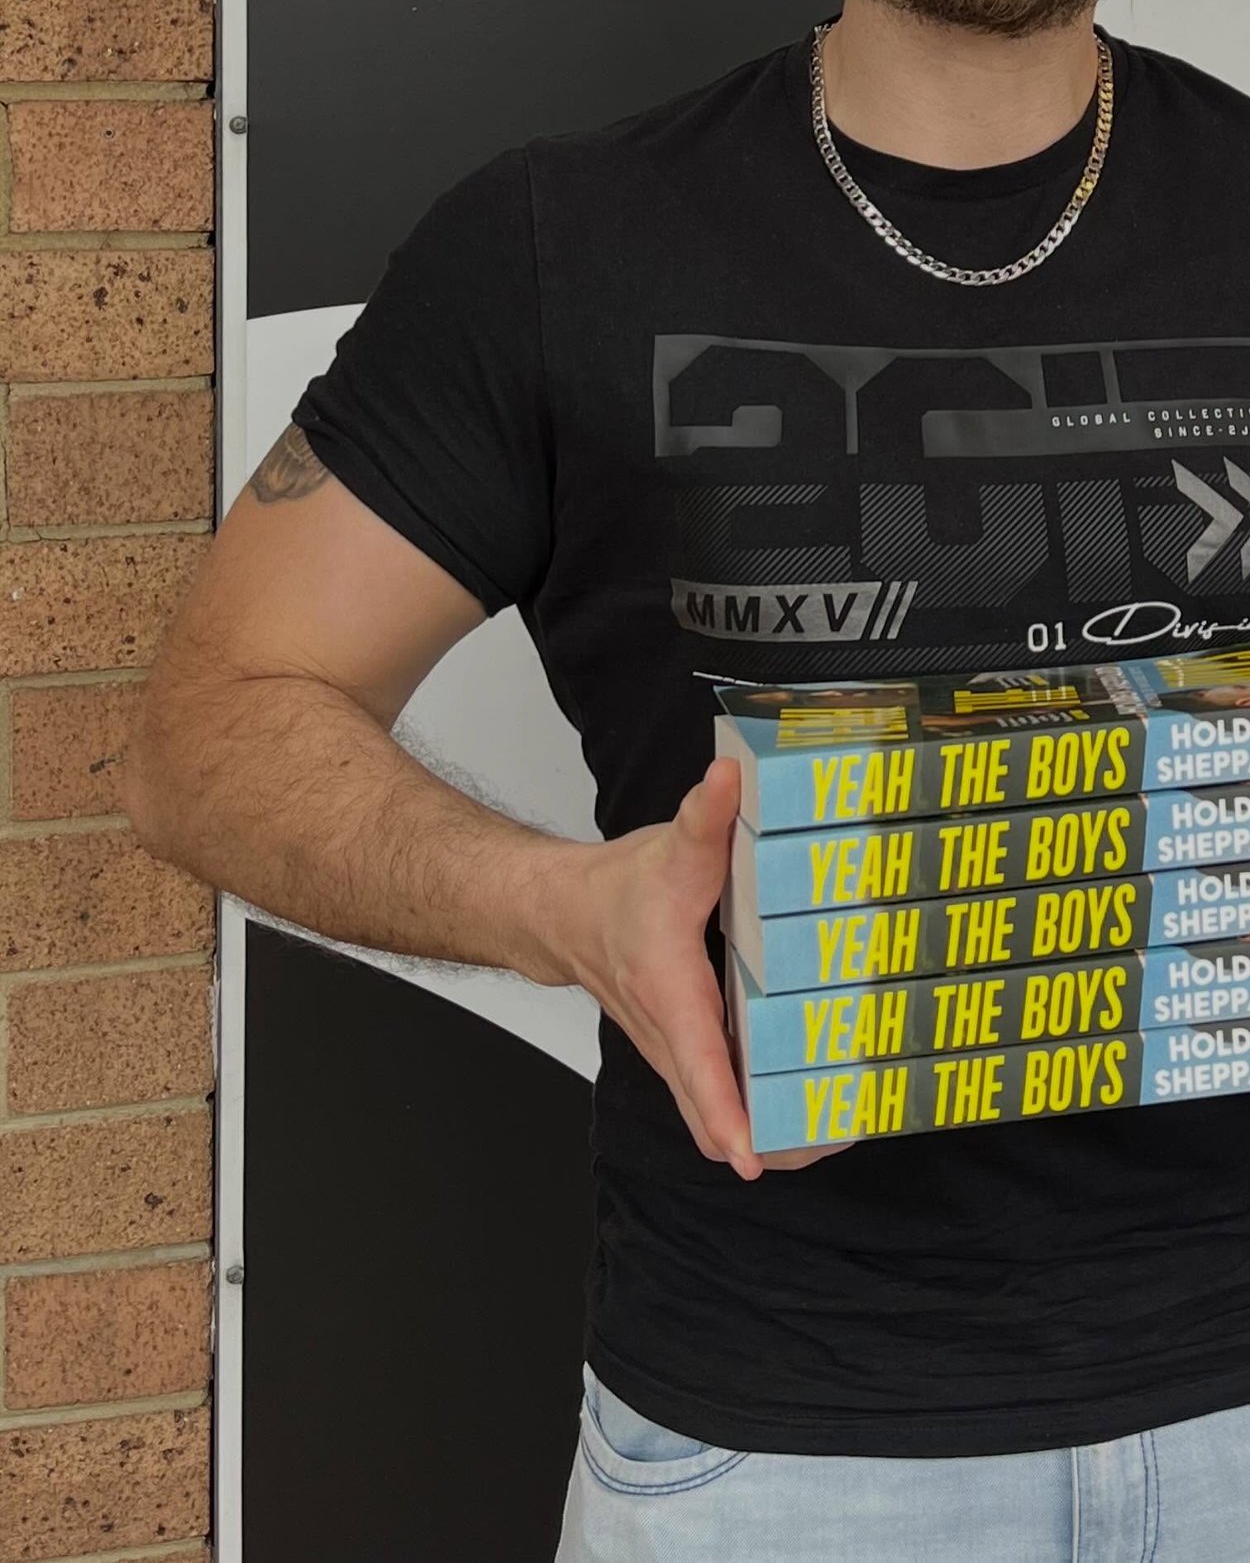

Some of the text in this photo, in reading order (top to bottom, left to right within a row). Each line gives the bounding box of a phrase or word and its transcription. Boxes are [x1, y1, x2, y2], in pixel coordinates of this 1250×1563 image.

[1052, 412, 1131, 427] GLOBAL
[1027, 622, 1068, 652] 01
[813, 727, 1130, 821] YEAH THE BOYS
[810, 806, 1130, 905] YEAH THE BOYS
[817, 883, 1136, 983] YEAH THE BOYS
[803, 965, 1127, 1064] YEAH THE BOYS
[804, 1040, 1127, 1144] YEAH THE BOYS
